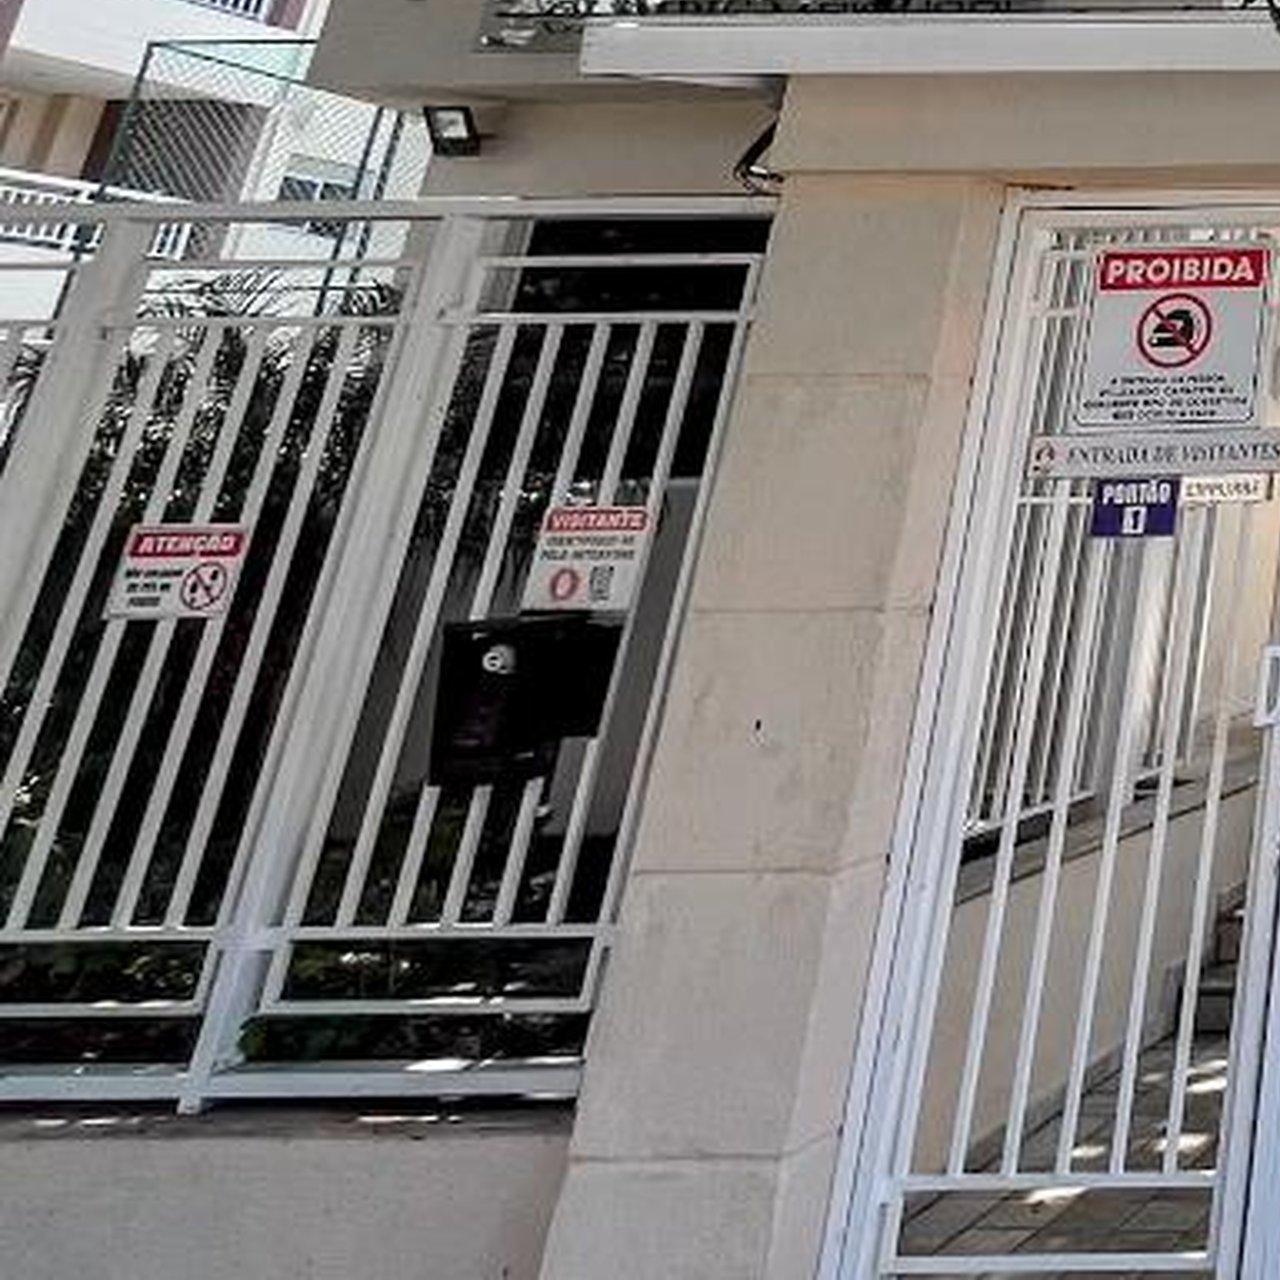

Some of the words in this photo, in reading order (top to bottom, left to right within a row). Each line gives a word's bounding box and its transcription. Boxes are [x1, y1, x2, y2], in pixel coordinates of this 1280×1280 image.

[1106, 257, 1255, 285] PROIBIDA
[1067, 444, 1148, 465] ENTRADA
[1155, 445, 1177, 463] DE
[1102, 480, 1172, 505] PORTÃO
